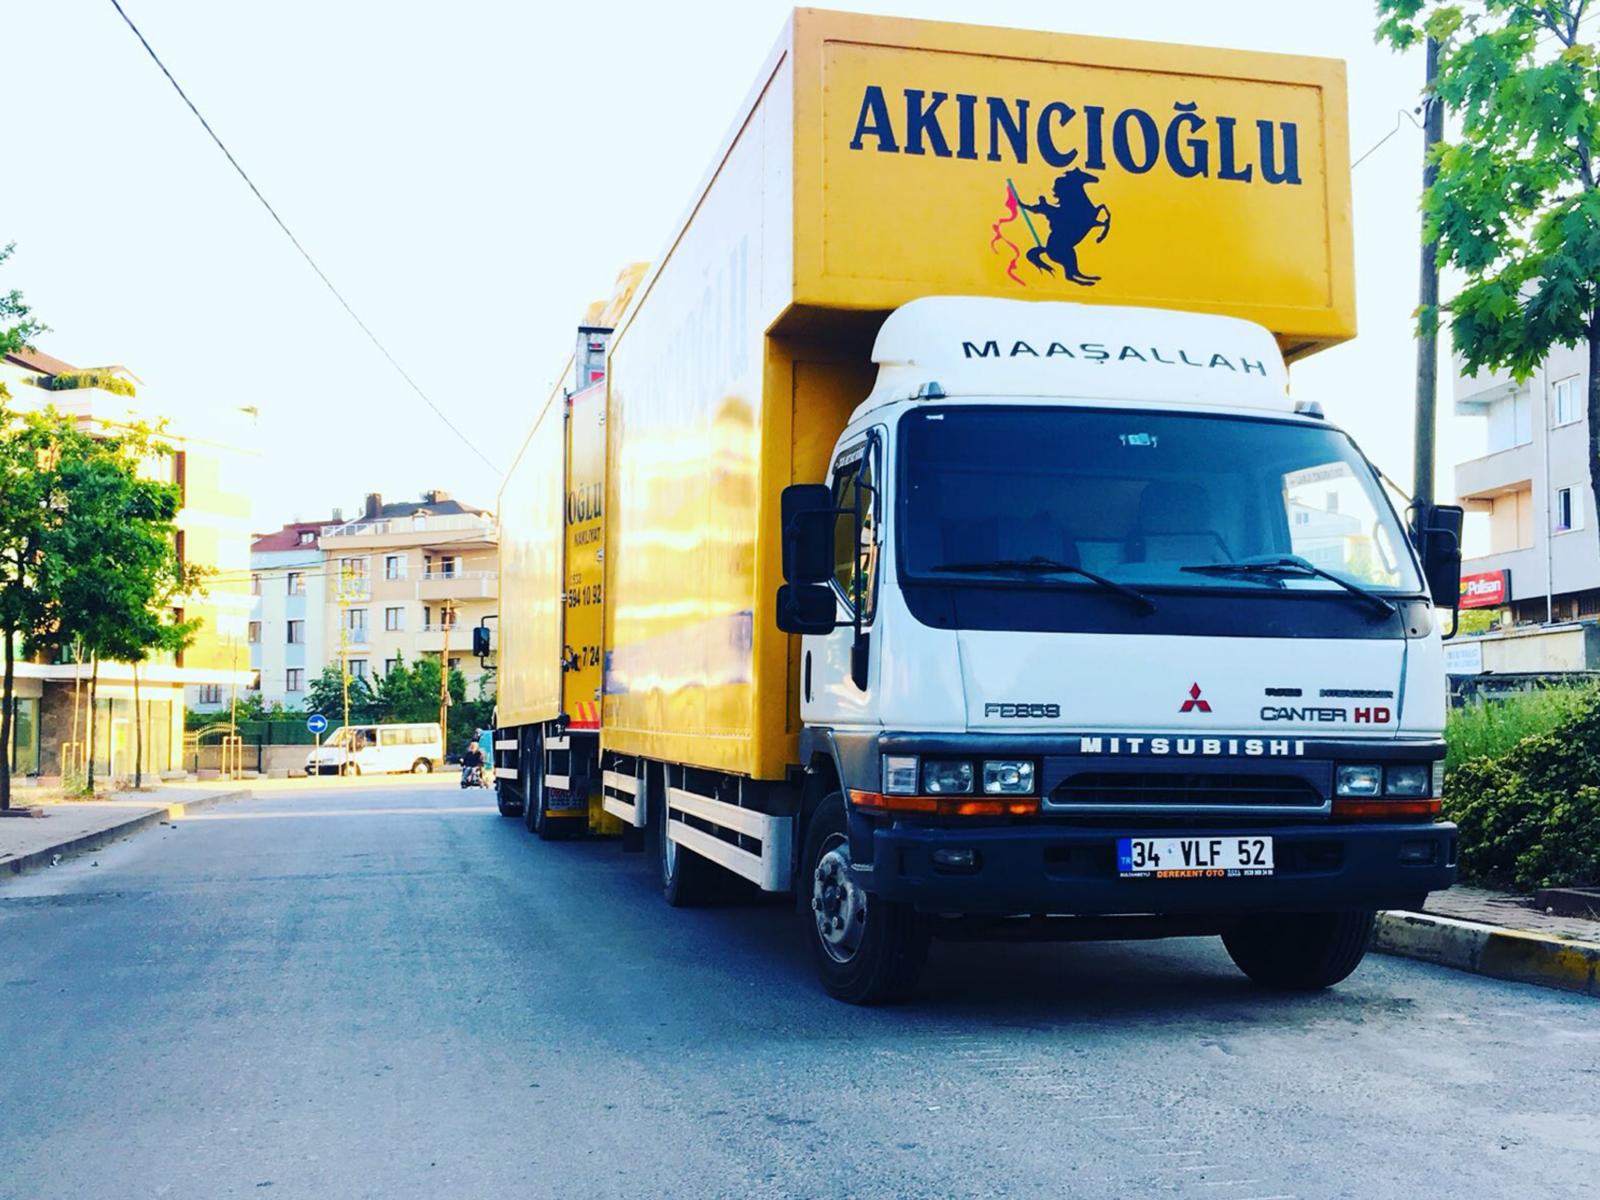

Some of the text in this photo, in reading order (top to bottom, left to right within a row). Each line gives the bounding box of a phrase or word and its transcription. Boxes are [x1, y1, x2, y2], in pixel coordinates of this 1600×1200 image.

[849, 84, 1303, 186] AKINCIOĞLU
[961, 339, 1268, 377] MAAŞALLAH
[1260, 706, 1390, 723] CANTER HD
[1080, 737, 1305, 755] MITSUBISHI
[1132, 839, 1266, 868] 34 VLF 52
[1156, 869, 1203, 879] DEREKENT
[1205, 868, 1225, 877] OTO
